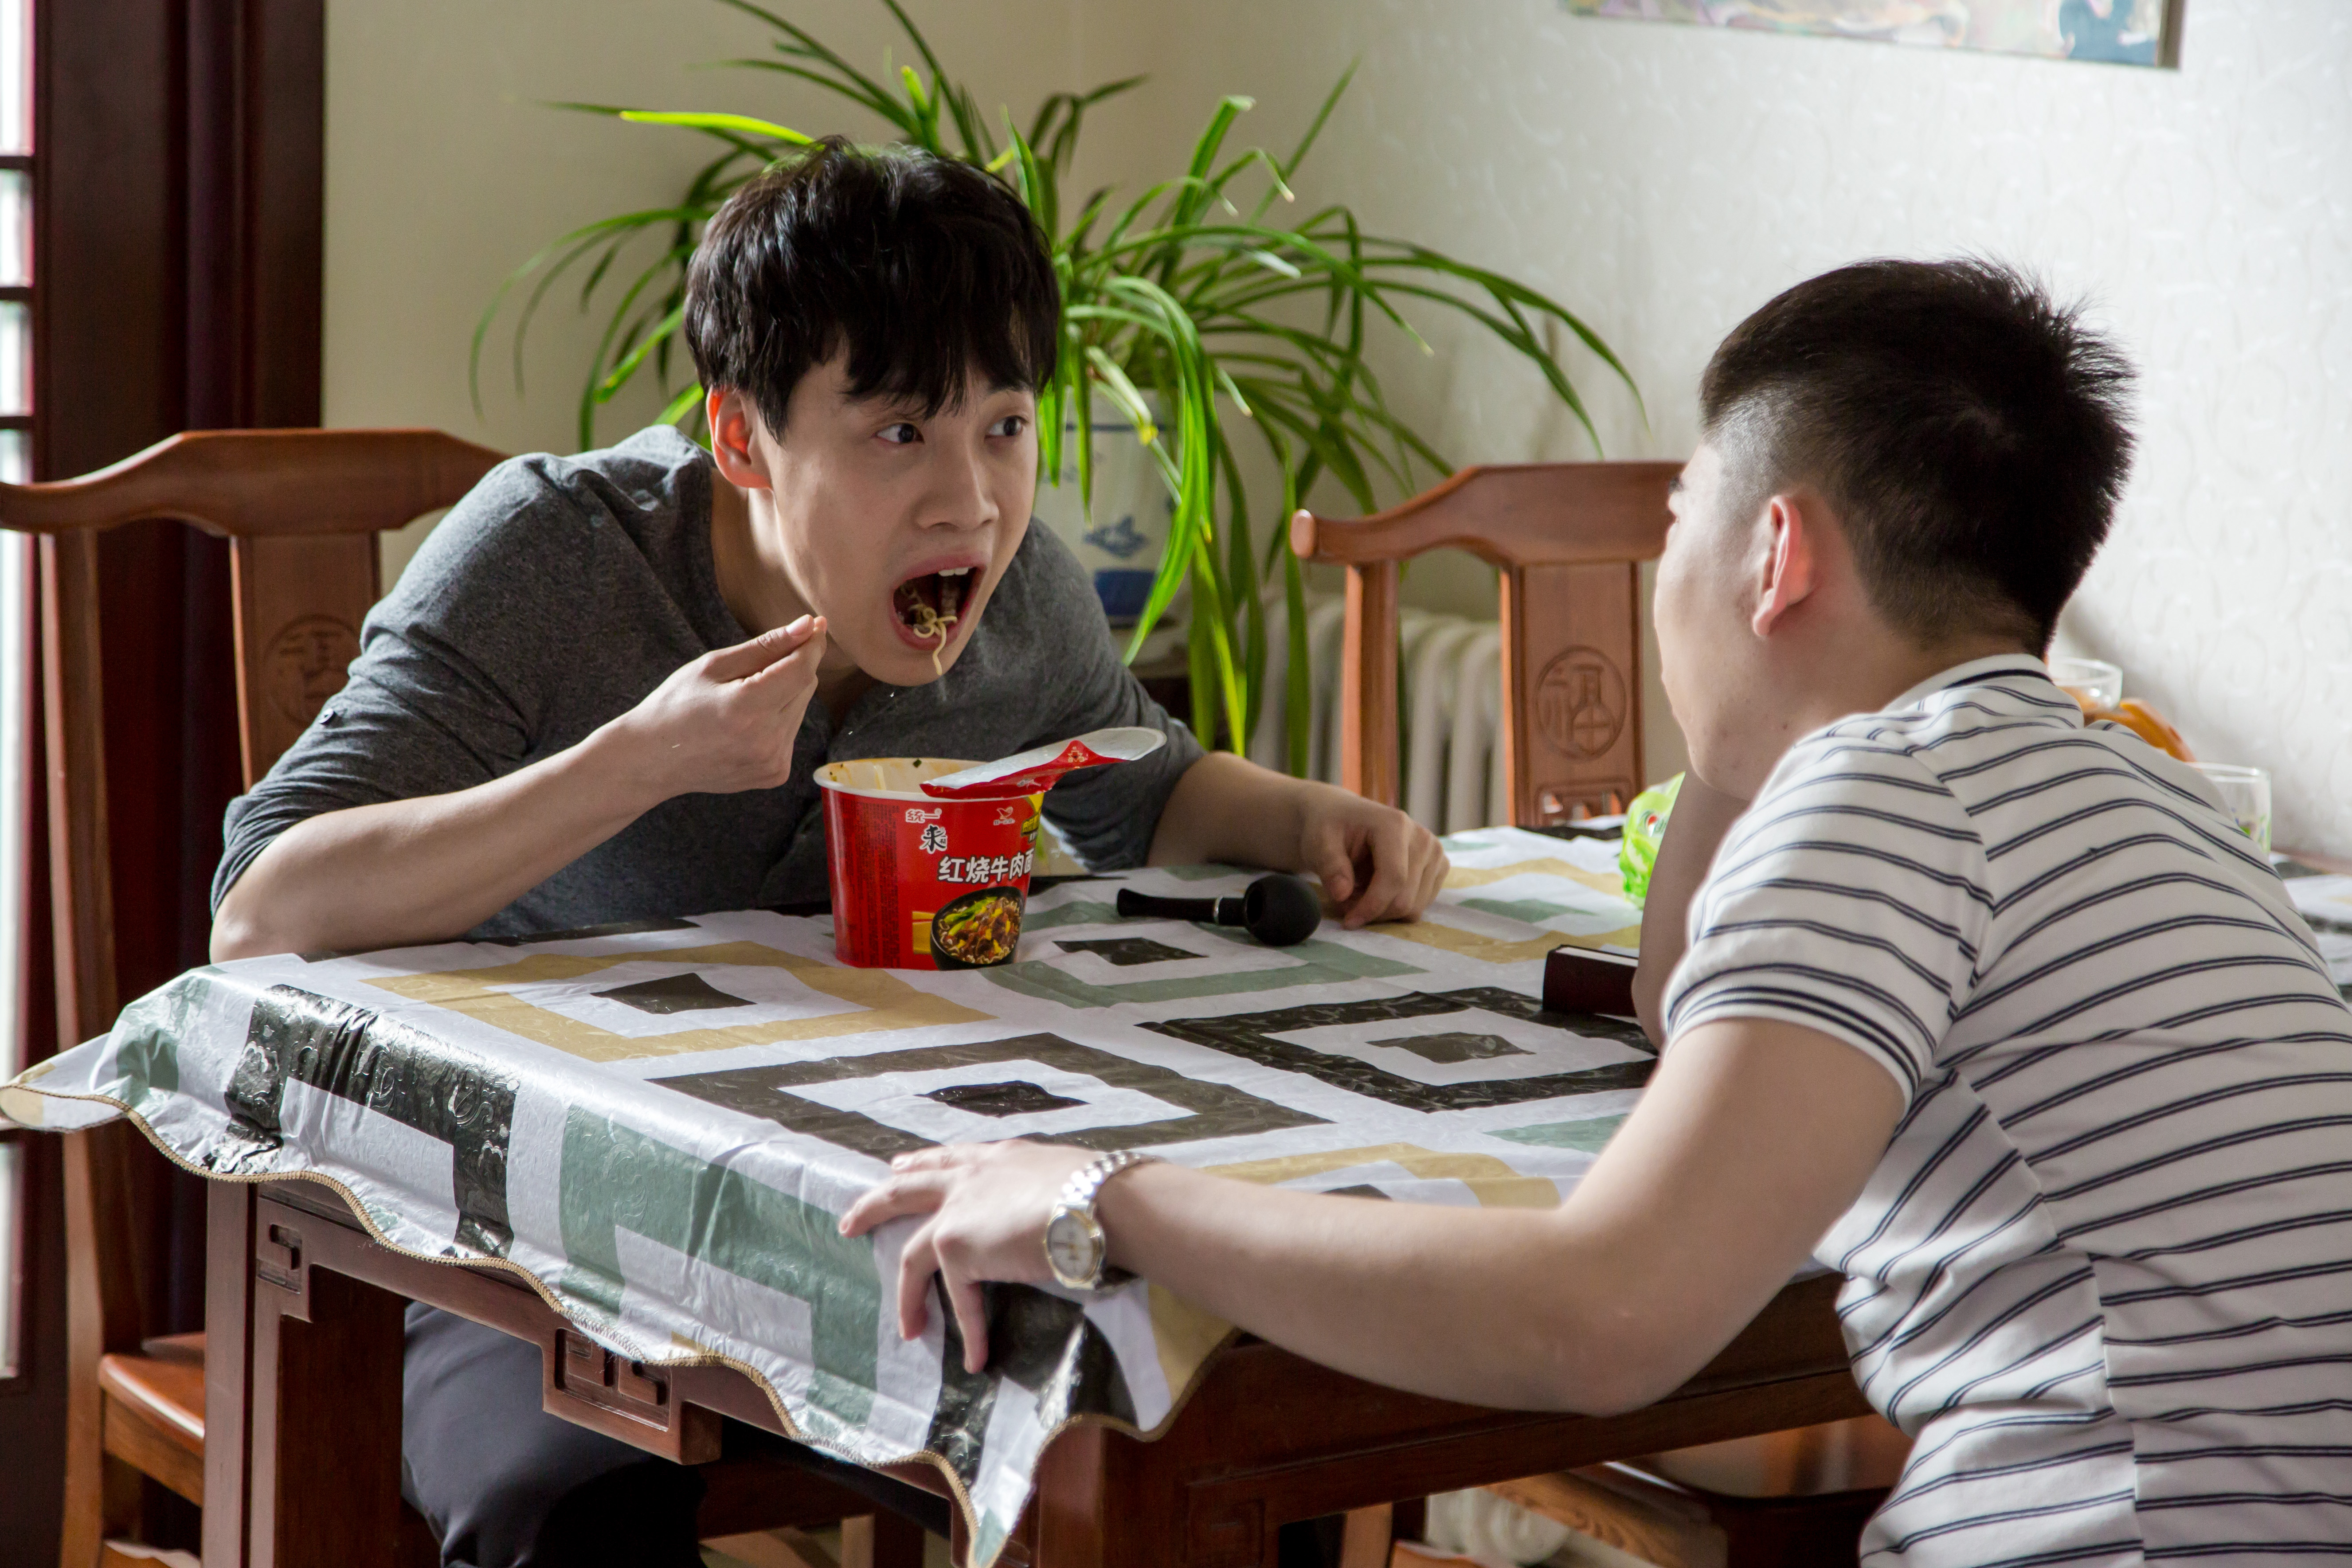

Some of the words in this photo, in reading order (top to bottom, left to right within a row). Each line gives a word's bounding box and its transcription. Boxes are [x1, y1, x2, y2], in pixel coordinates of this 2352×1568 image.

[906, 809, 939, 822] 统一
[938, 848, 1034, 884] 红烧牛肉面
